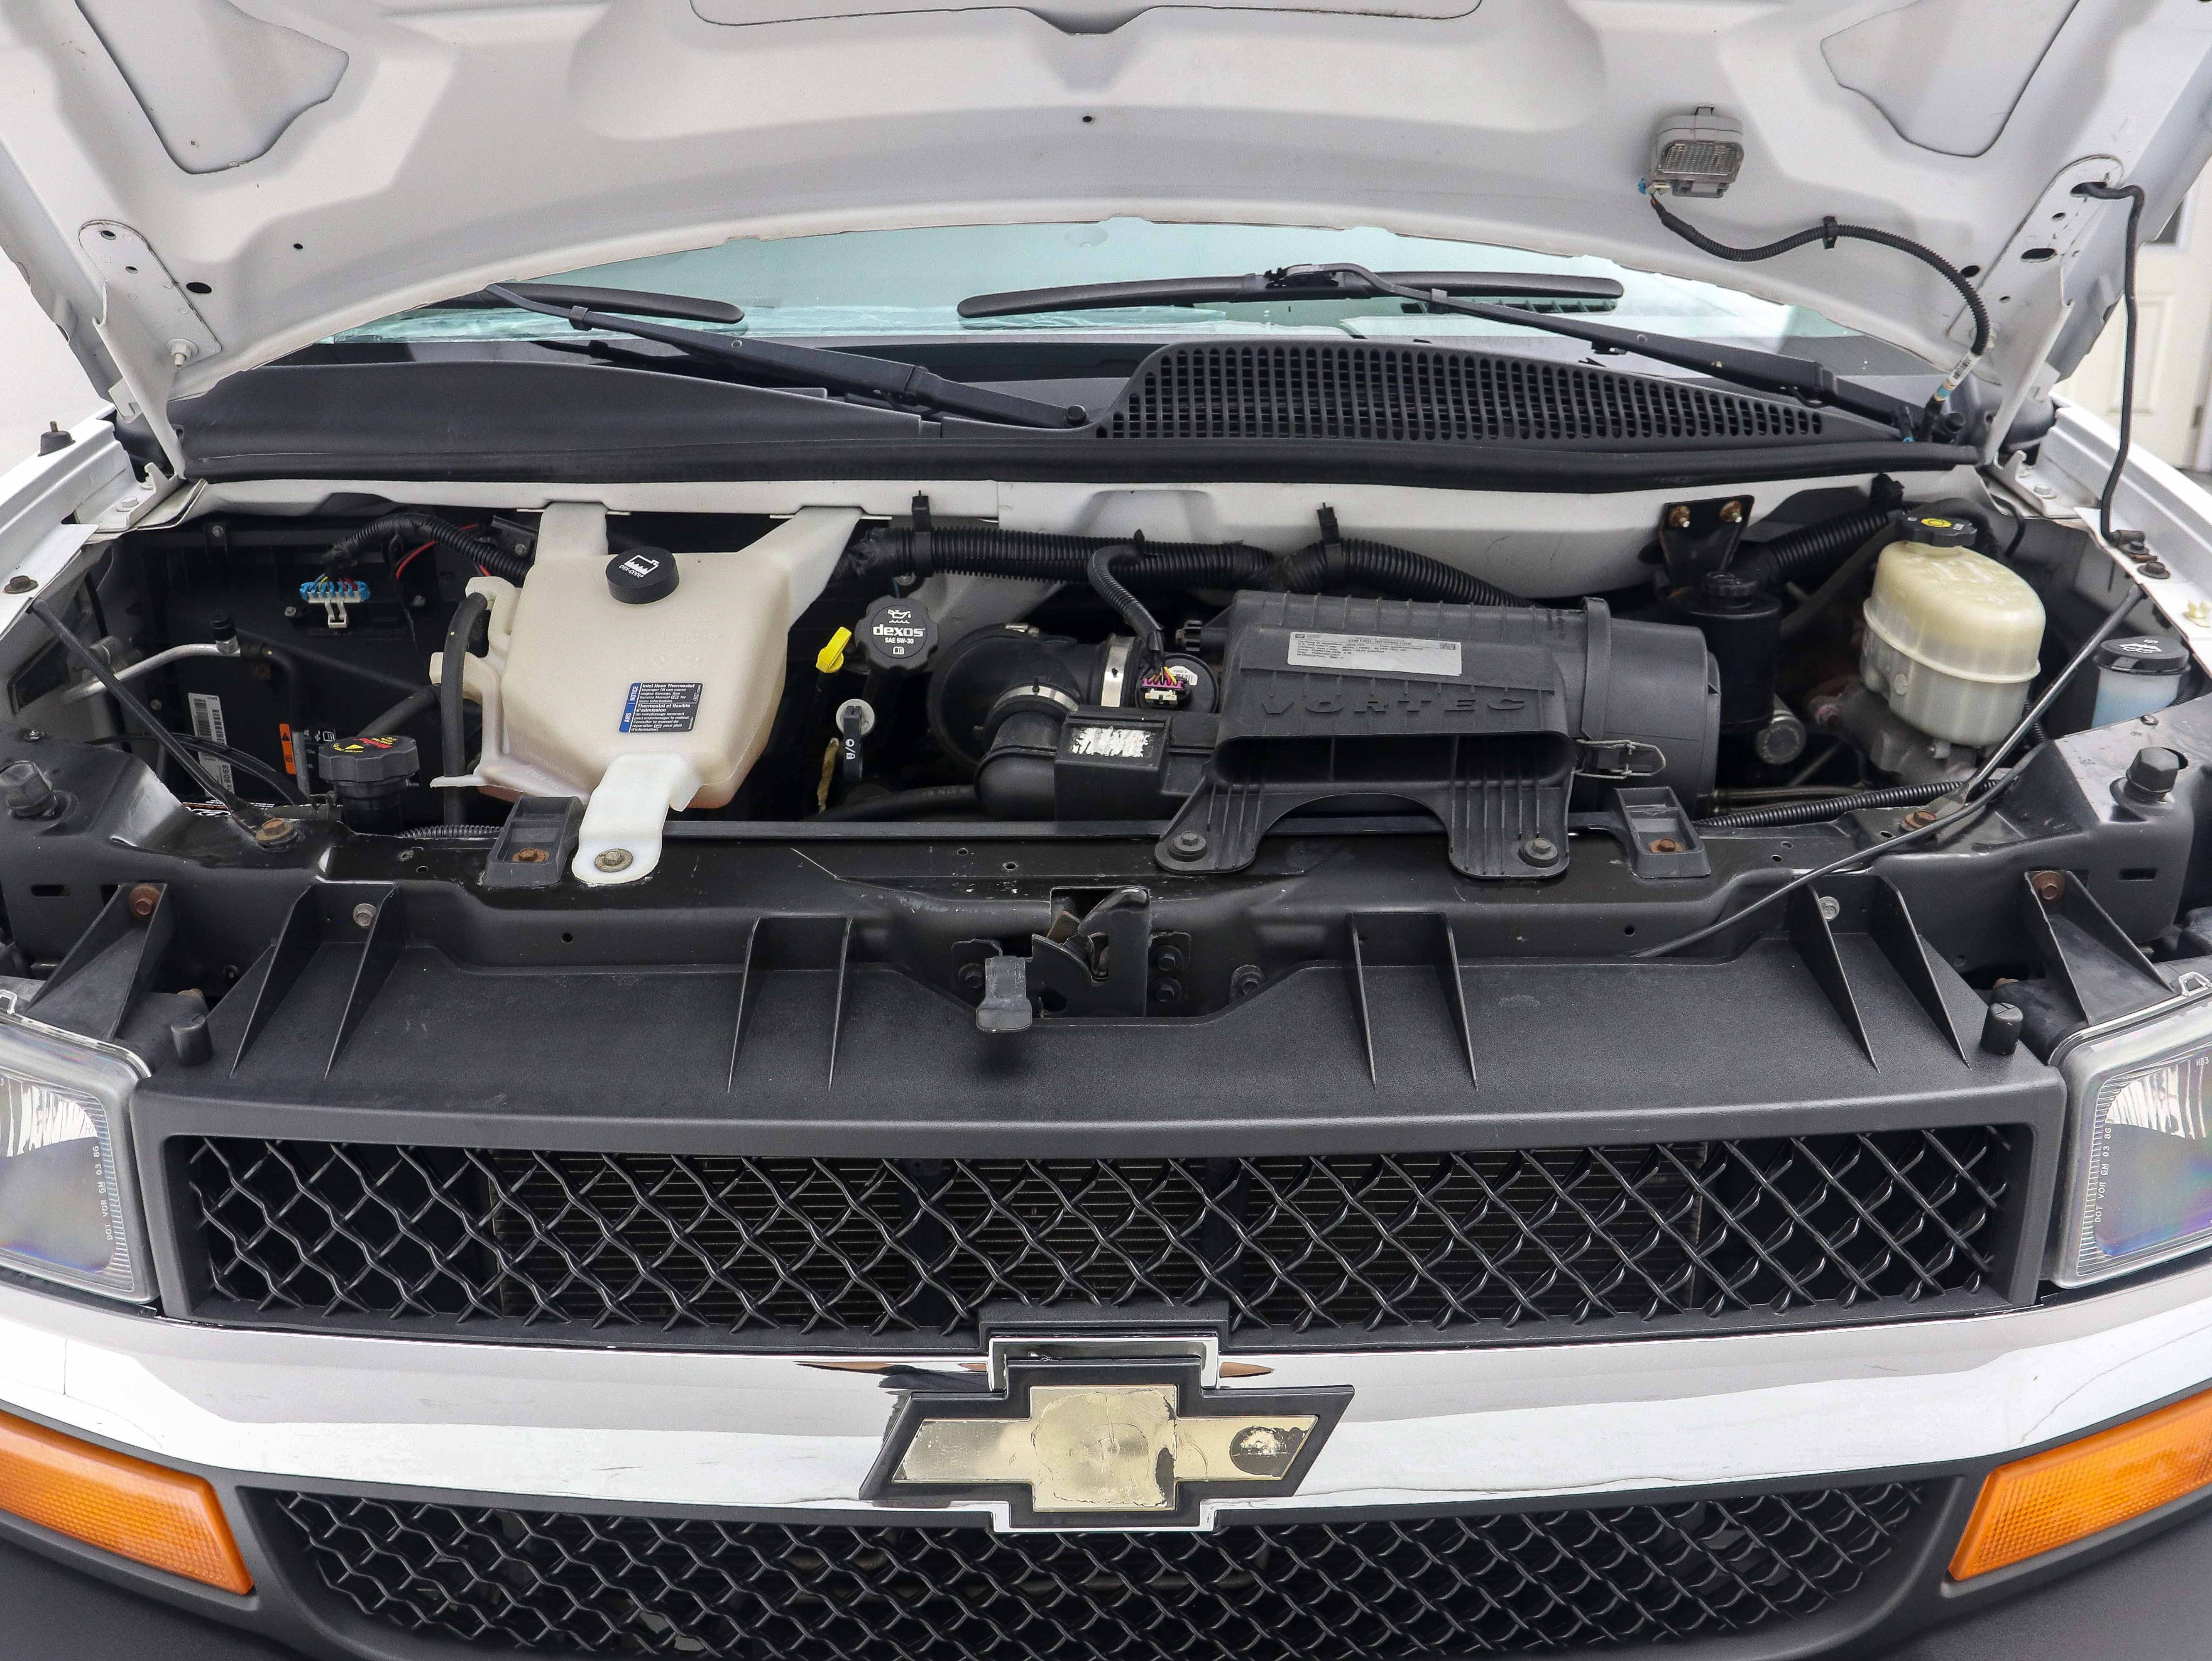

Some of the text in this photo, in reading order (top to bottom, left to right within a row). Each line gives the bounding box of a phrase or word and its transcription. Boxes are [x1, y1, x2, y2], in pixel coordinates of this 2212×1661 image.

[873, 624, 925, 637] dexos
[629, 686, 639, 701] NOTICE
[1261, 698, 1526, 714] VORTEC
[2196, 1057, 2209, 1066] HB3
[2102, 1146, 2110, 1157] 03
[95, 1164, 102, 1176] 03
[2101, 1164, 2109, 1176] GM
[98, 1181, 106, 1194] GM
[2097, 1182, 2106, 1199] VOR
